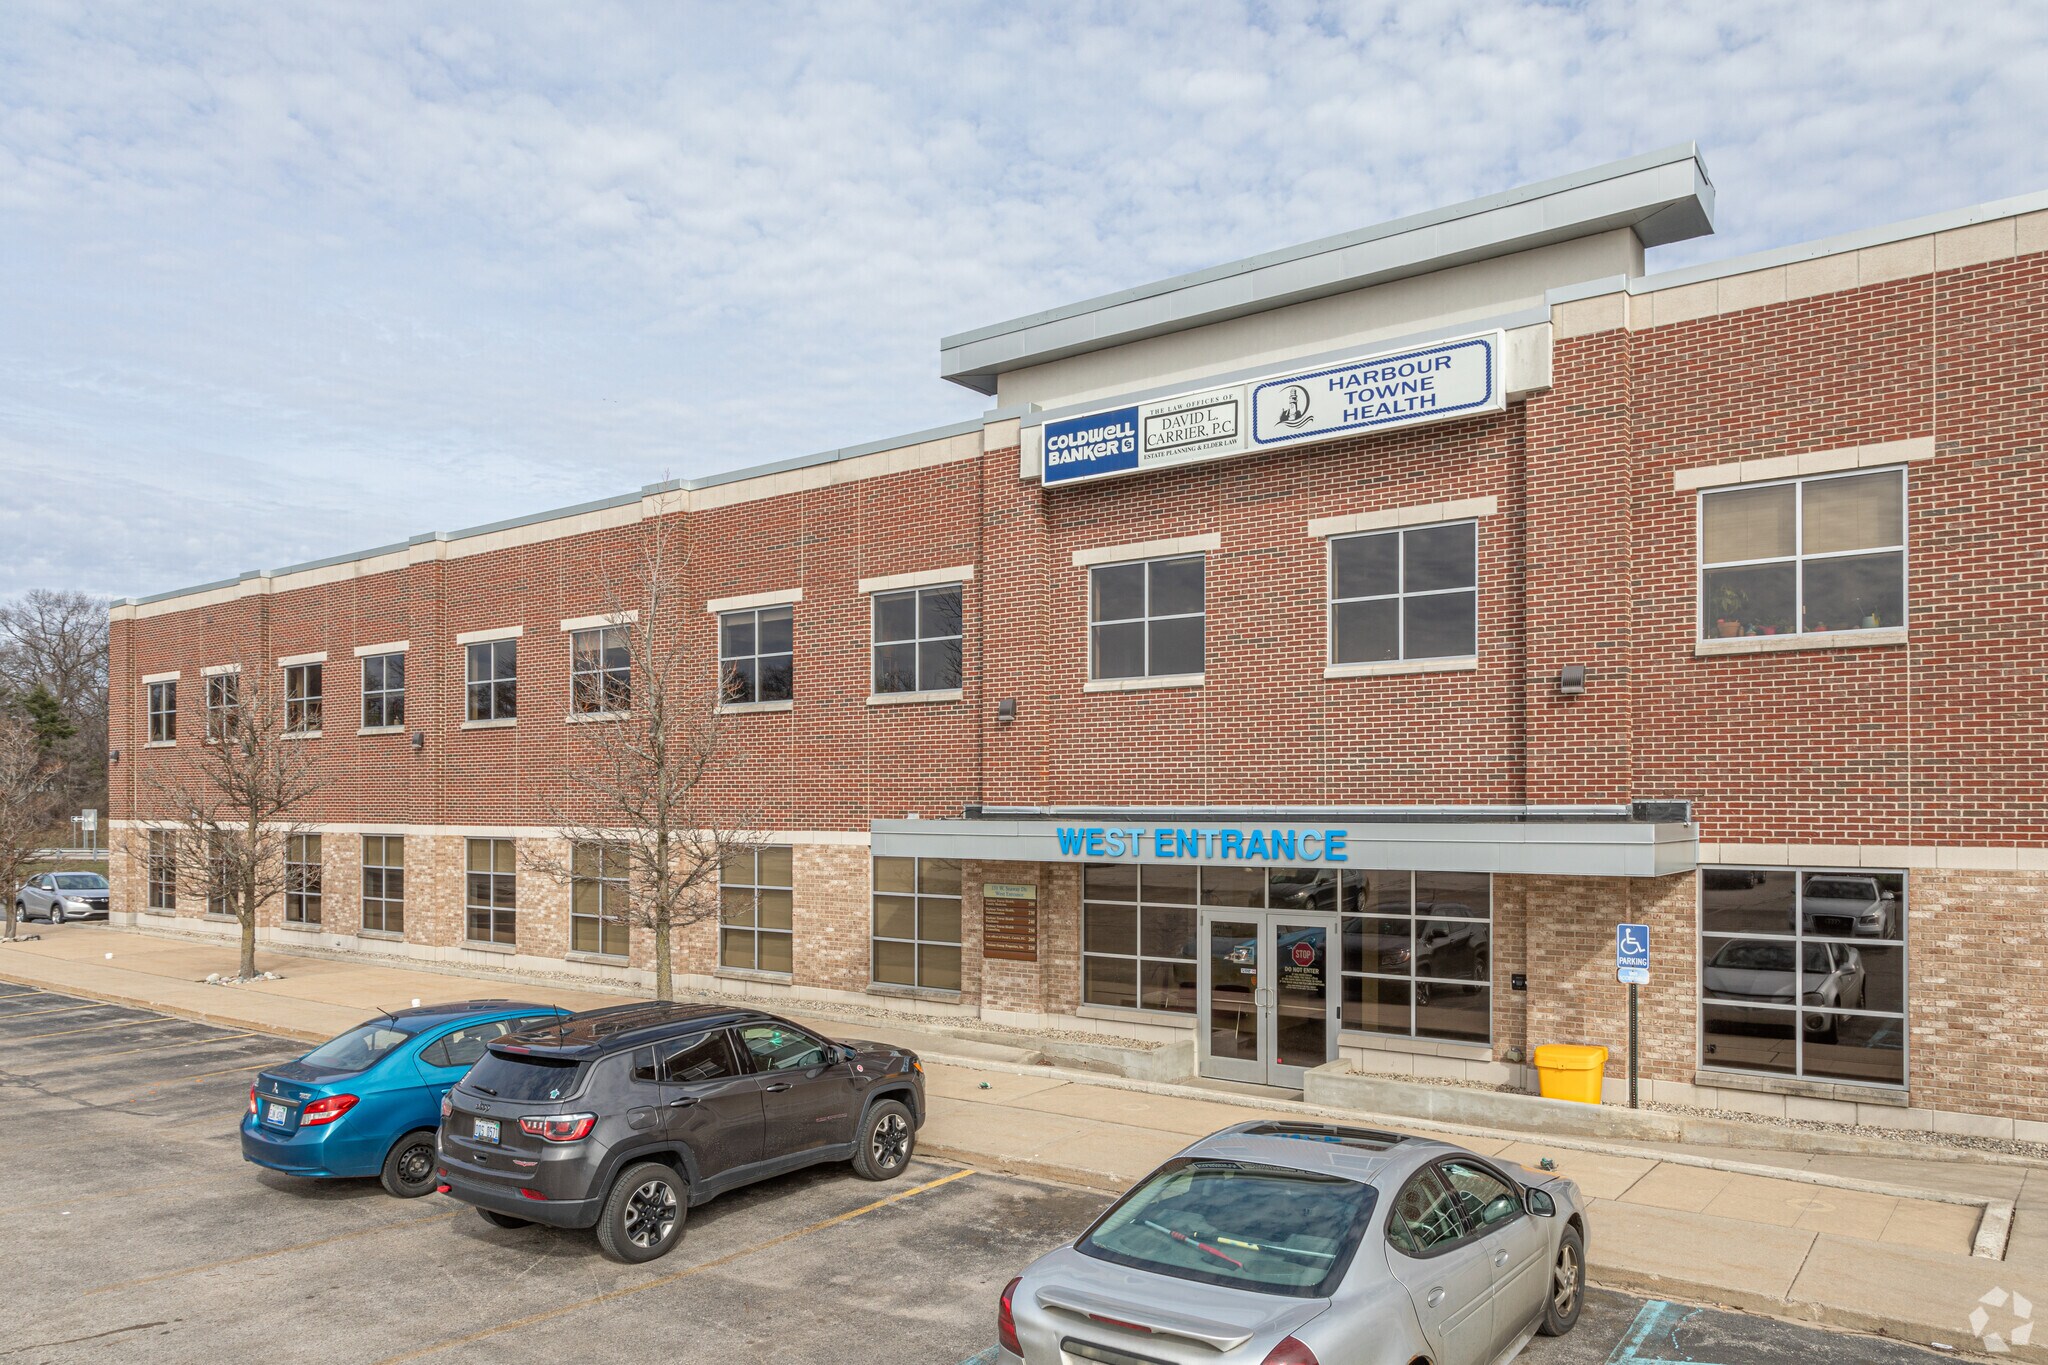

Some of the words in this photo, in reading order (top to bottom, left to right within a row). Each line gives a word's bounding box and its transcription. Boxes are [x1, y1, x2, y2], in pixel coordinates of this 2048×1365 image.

[1329, 355, 1452, 391] HARBOUR
[1186, 397, 1219, 407] OFFICES
[1344, 376, 1434, 404] TOWNE
[1162, 411, 1204, 430] DAVID
[1207, 409, 1218, 421] L.
[1343, 393, 1436, 422] HEALTH
[1147, 425, 1208, 446] CARRIER,
[1212, 420, 1234, 434] P.C.
[1144, 451, 1166, 460] ESTATE
[1166, 446, 1196, 456] PLANNING
[1203, 441, 1224, 450] ELDER
[1224, 438, 1238, 446] LAW
[1056, 827, 1145, 857] WEST
[1155, 828, 1348, 861] ENTRANCE
[1295, 949, 1311, 959] STOP
[1619, 957, 1647, 966] PARKING
